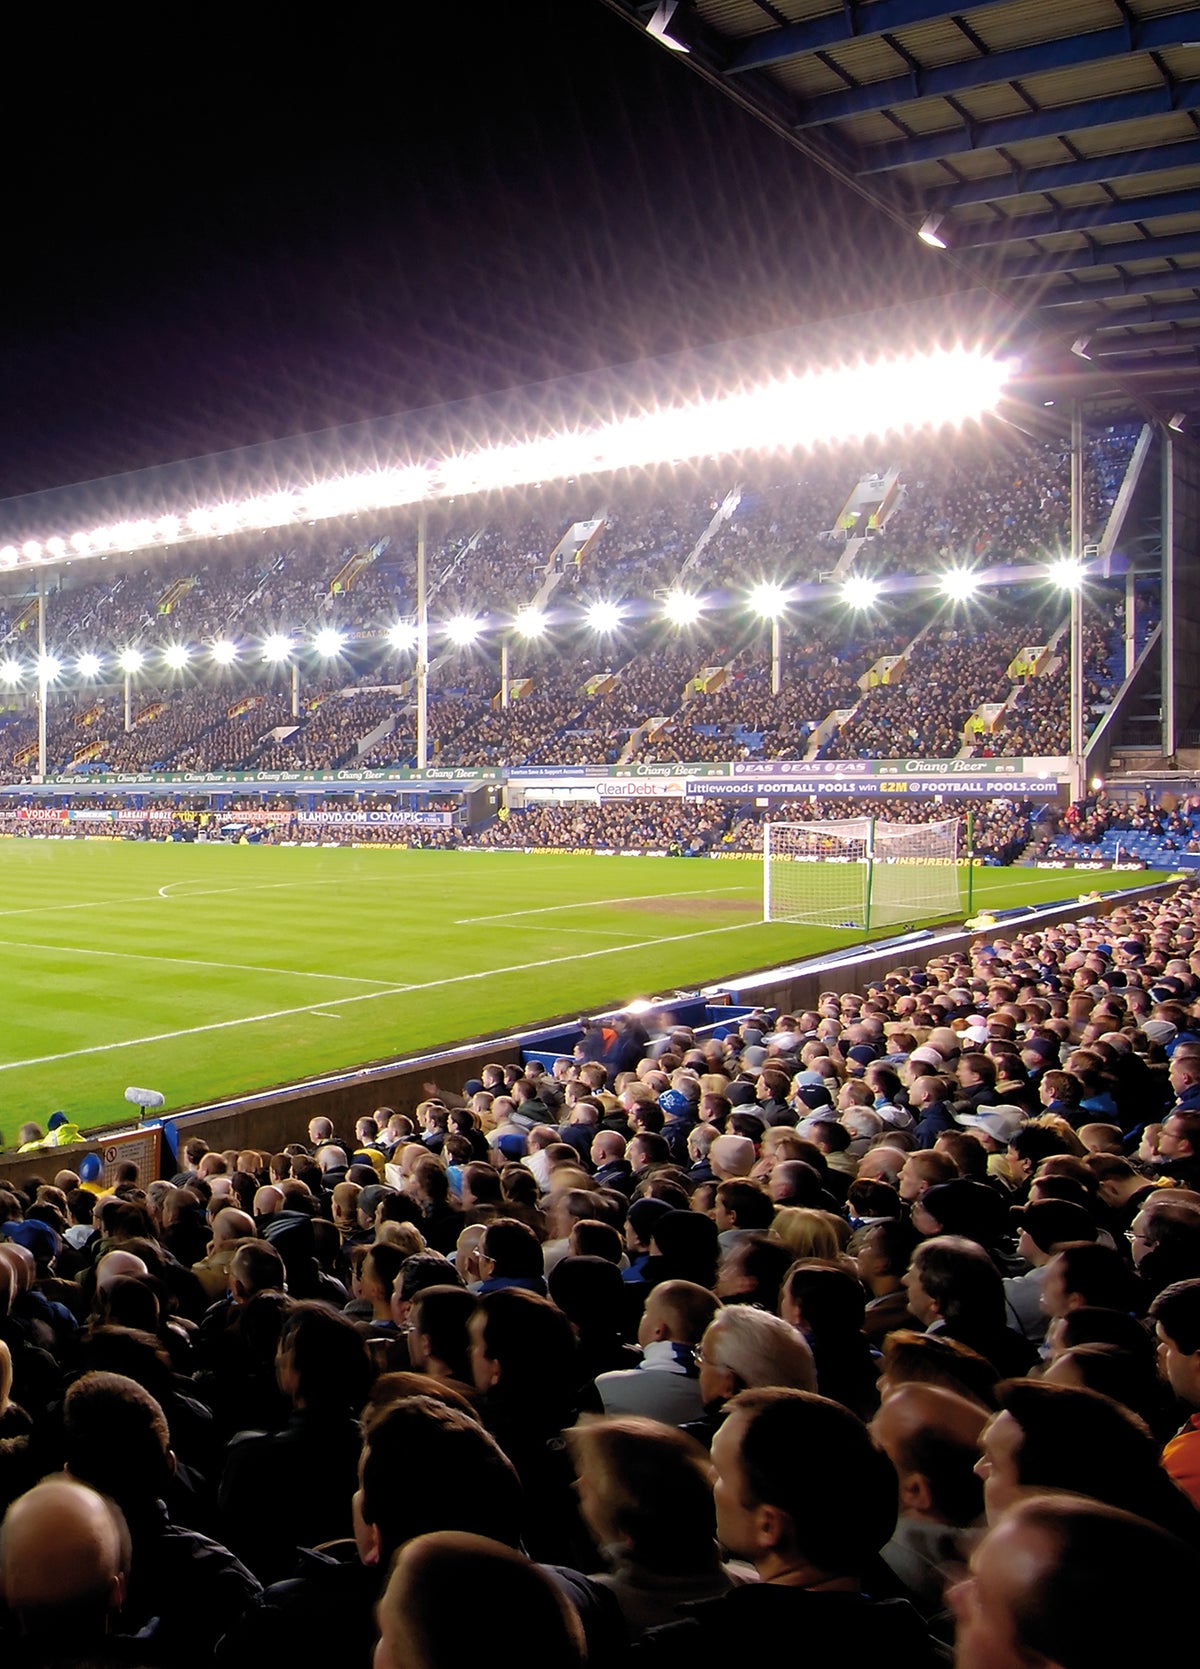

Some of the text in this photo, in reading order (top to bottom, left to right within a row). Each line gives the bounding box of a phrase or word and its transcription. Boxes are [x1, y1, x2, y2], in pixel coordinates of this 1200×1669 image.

[636, 764, 701, 777] Chang Beer
[905, 760, 986, 774] Chang Beer
[426, 768, 478, 781] Chang Beer
[596, 783, 657, 795] ClearDebt
[687, 782, 754, 794] Littlewoods
[757, 783, 816, 793] FOOTBALL
[818, 783, 855, 793] POOLS
[859, 782, 877, 792] win
[880, 782, 908, 792] £2M
[922, 782, 983, 792] FOOTBALL
[986, 782, 1057, 792] POOLS.com
[26, 810, 62, 819] VODKAT
[297, 811, 367, 822] BLAHDVD.COM
[370, 811, 423, 822] OLYMPIC
